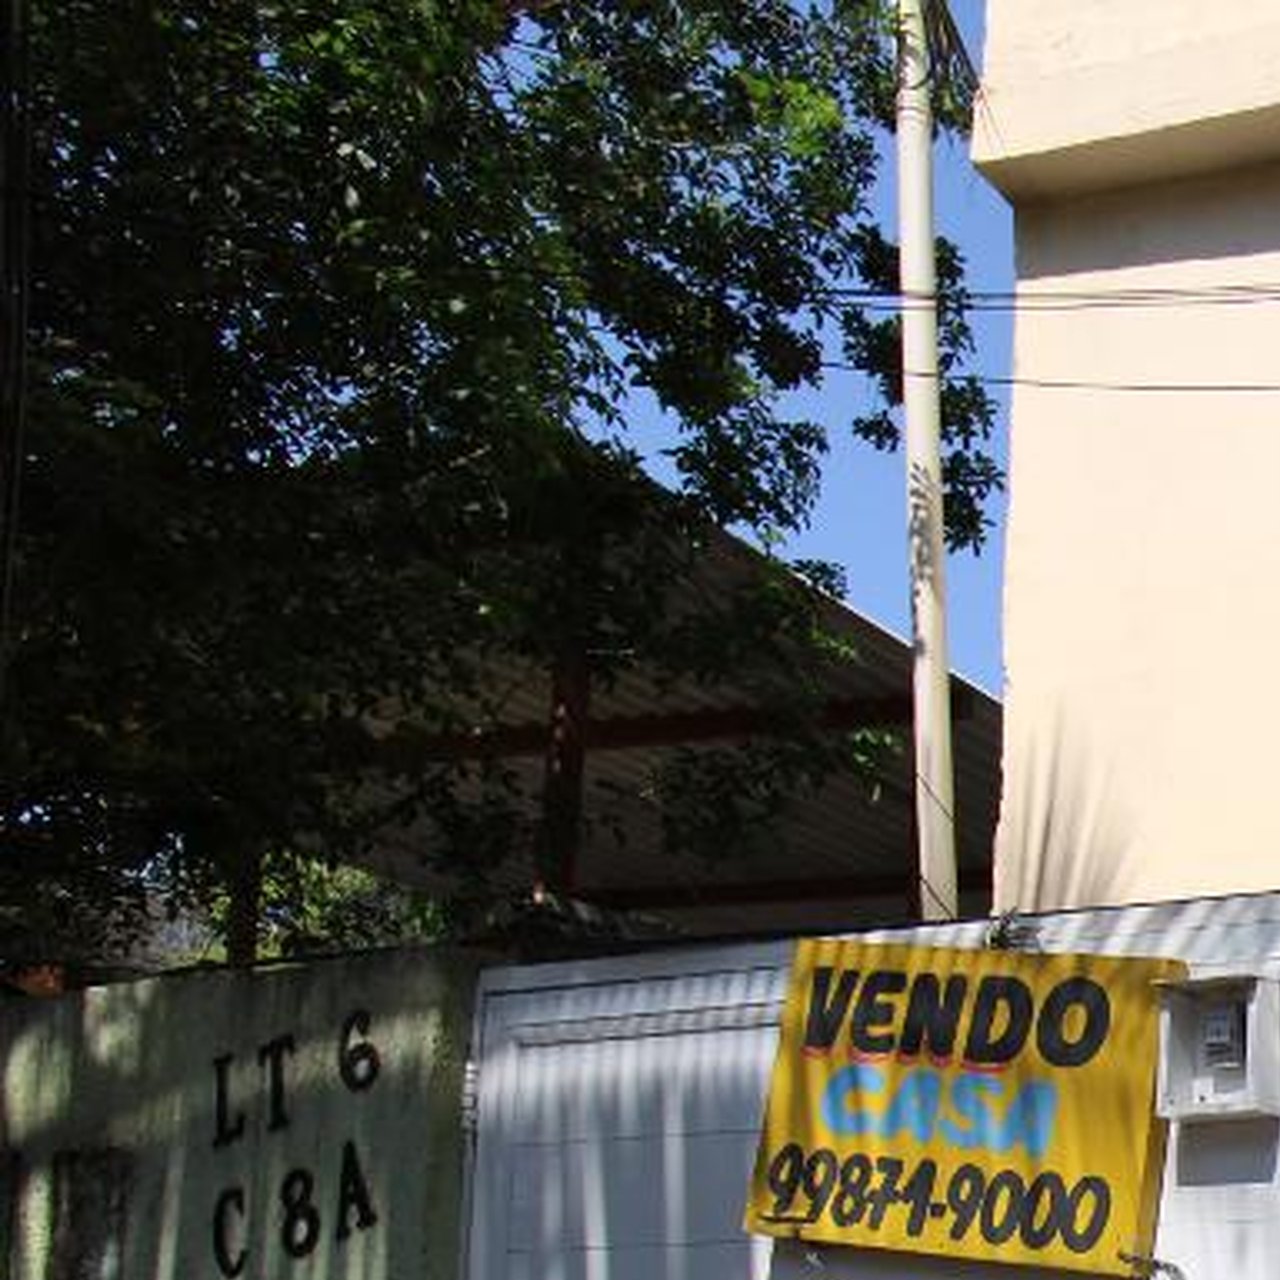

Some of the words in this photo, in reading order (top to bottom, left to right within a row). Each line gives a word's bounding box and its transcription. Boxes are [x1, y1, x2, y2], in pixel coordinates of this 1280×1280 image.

[803, 965, 1111, 1068] VENDO
[212, 1034, 296, 1148] LT
[339, 1009, 381, 1093] 6
[820, 1064, 1058, 1160] CASA
